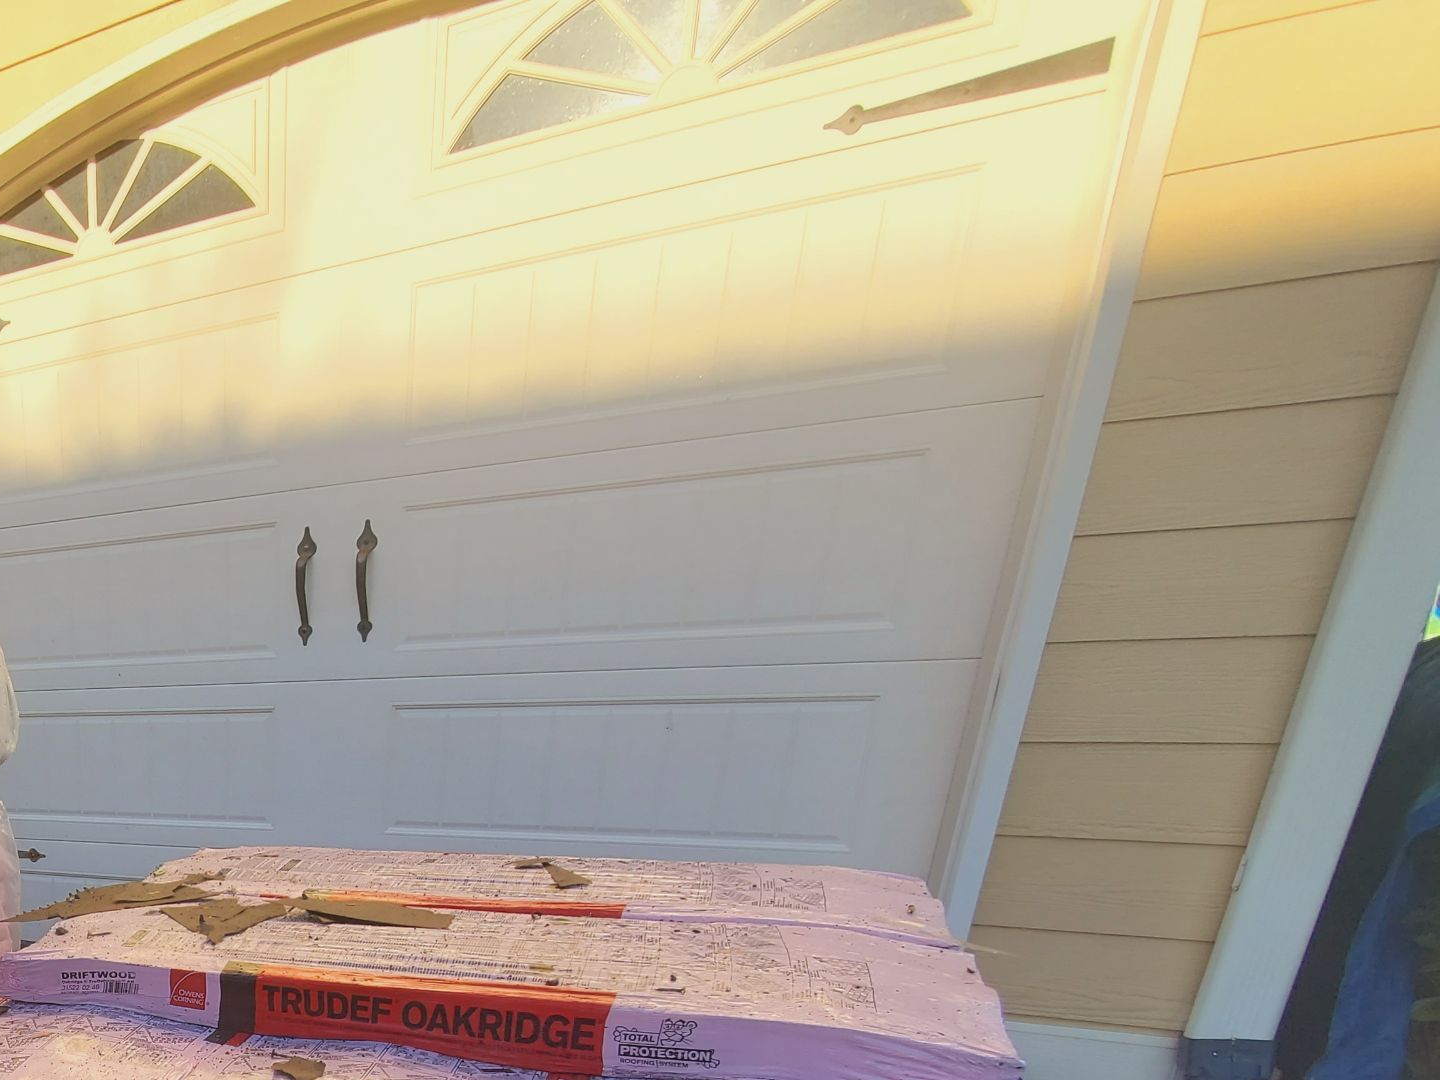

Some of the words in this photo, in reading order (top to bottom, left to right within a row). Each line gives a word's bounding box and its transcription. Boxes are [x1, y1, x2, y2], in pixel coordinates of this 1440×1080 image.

[61, 970, 136, 980] DRIFTWOOD
[178, 989, 205, 999] OWENS
[173, 995, 204, 1006] CORNING
[262, 984, 392, 1025] TRUDEF
[401, 1001, 596, 1051] OAKRIDGE
[622, 1032, 656, 1043] TOTAL
[620, 1045, 713, 1062] PROTECTION
[620, 1057, 656, 1067] ROOFING
[659, 1060, 689, 1069] SYSTEM
